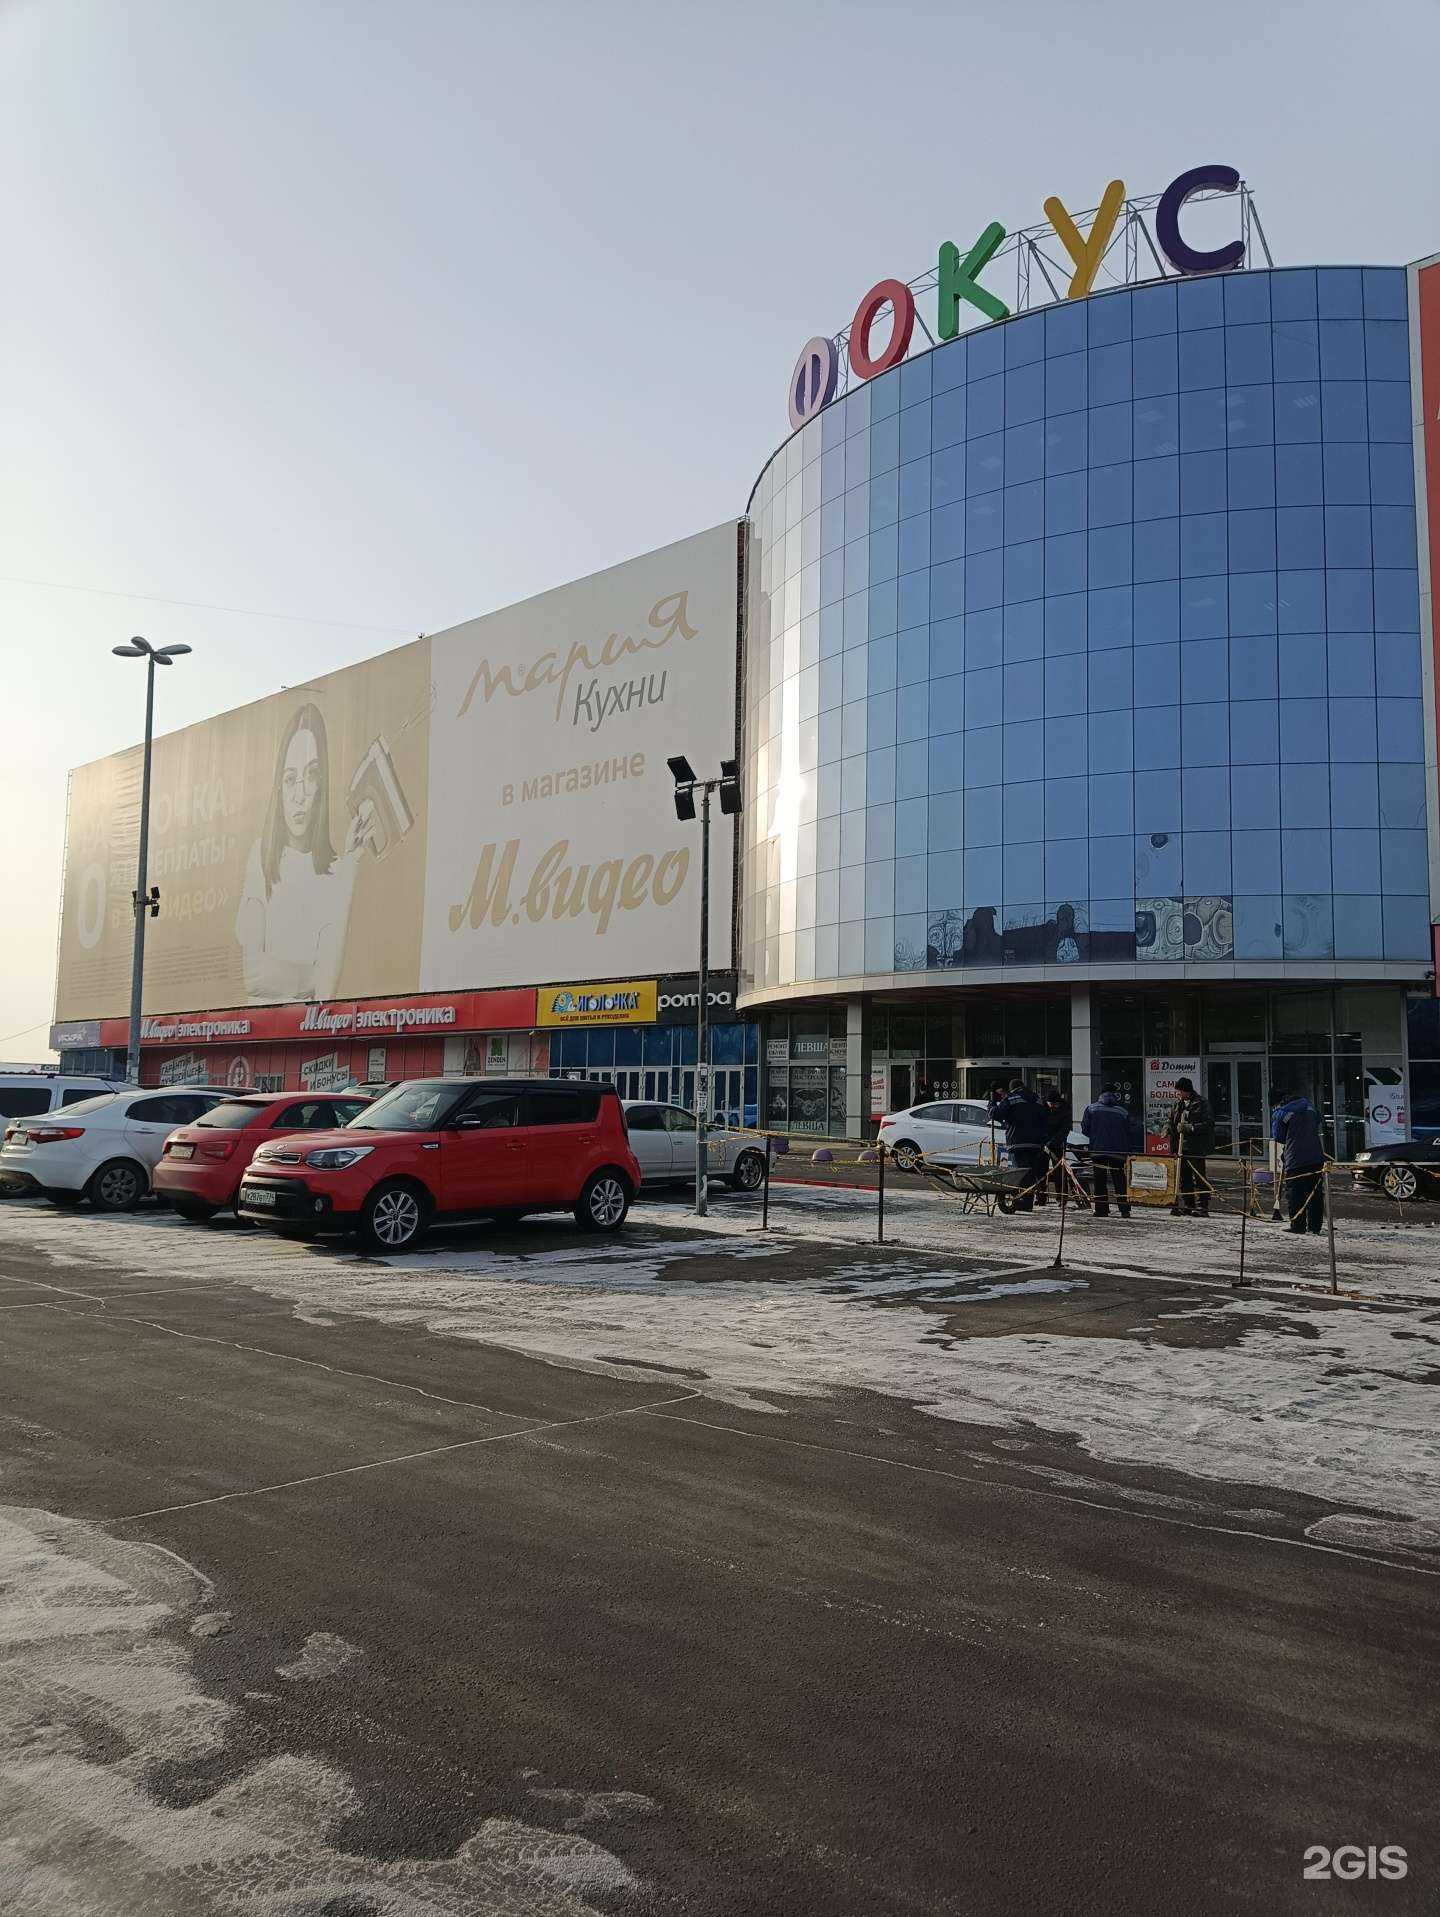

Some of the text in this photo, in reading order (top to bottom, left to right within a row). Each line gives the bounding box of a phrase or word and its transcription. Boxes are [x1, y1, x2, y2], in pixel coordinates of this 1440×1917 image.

[789, 164, 1246, 432] ФОКУС
[573, 670, 668, 732] Кухни
[521, 752, 646, 804] магазине
[178, 1020, 251, 1041] электроника
[356, 1006, 456, 1033] электроника
[303, 1058, 334, 1076] СКИДКИ
